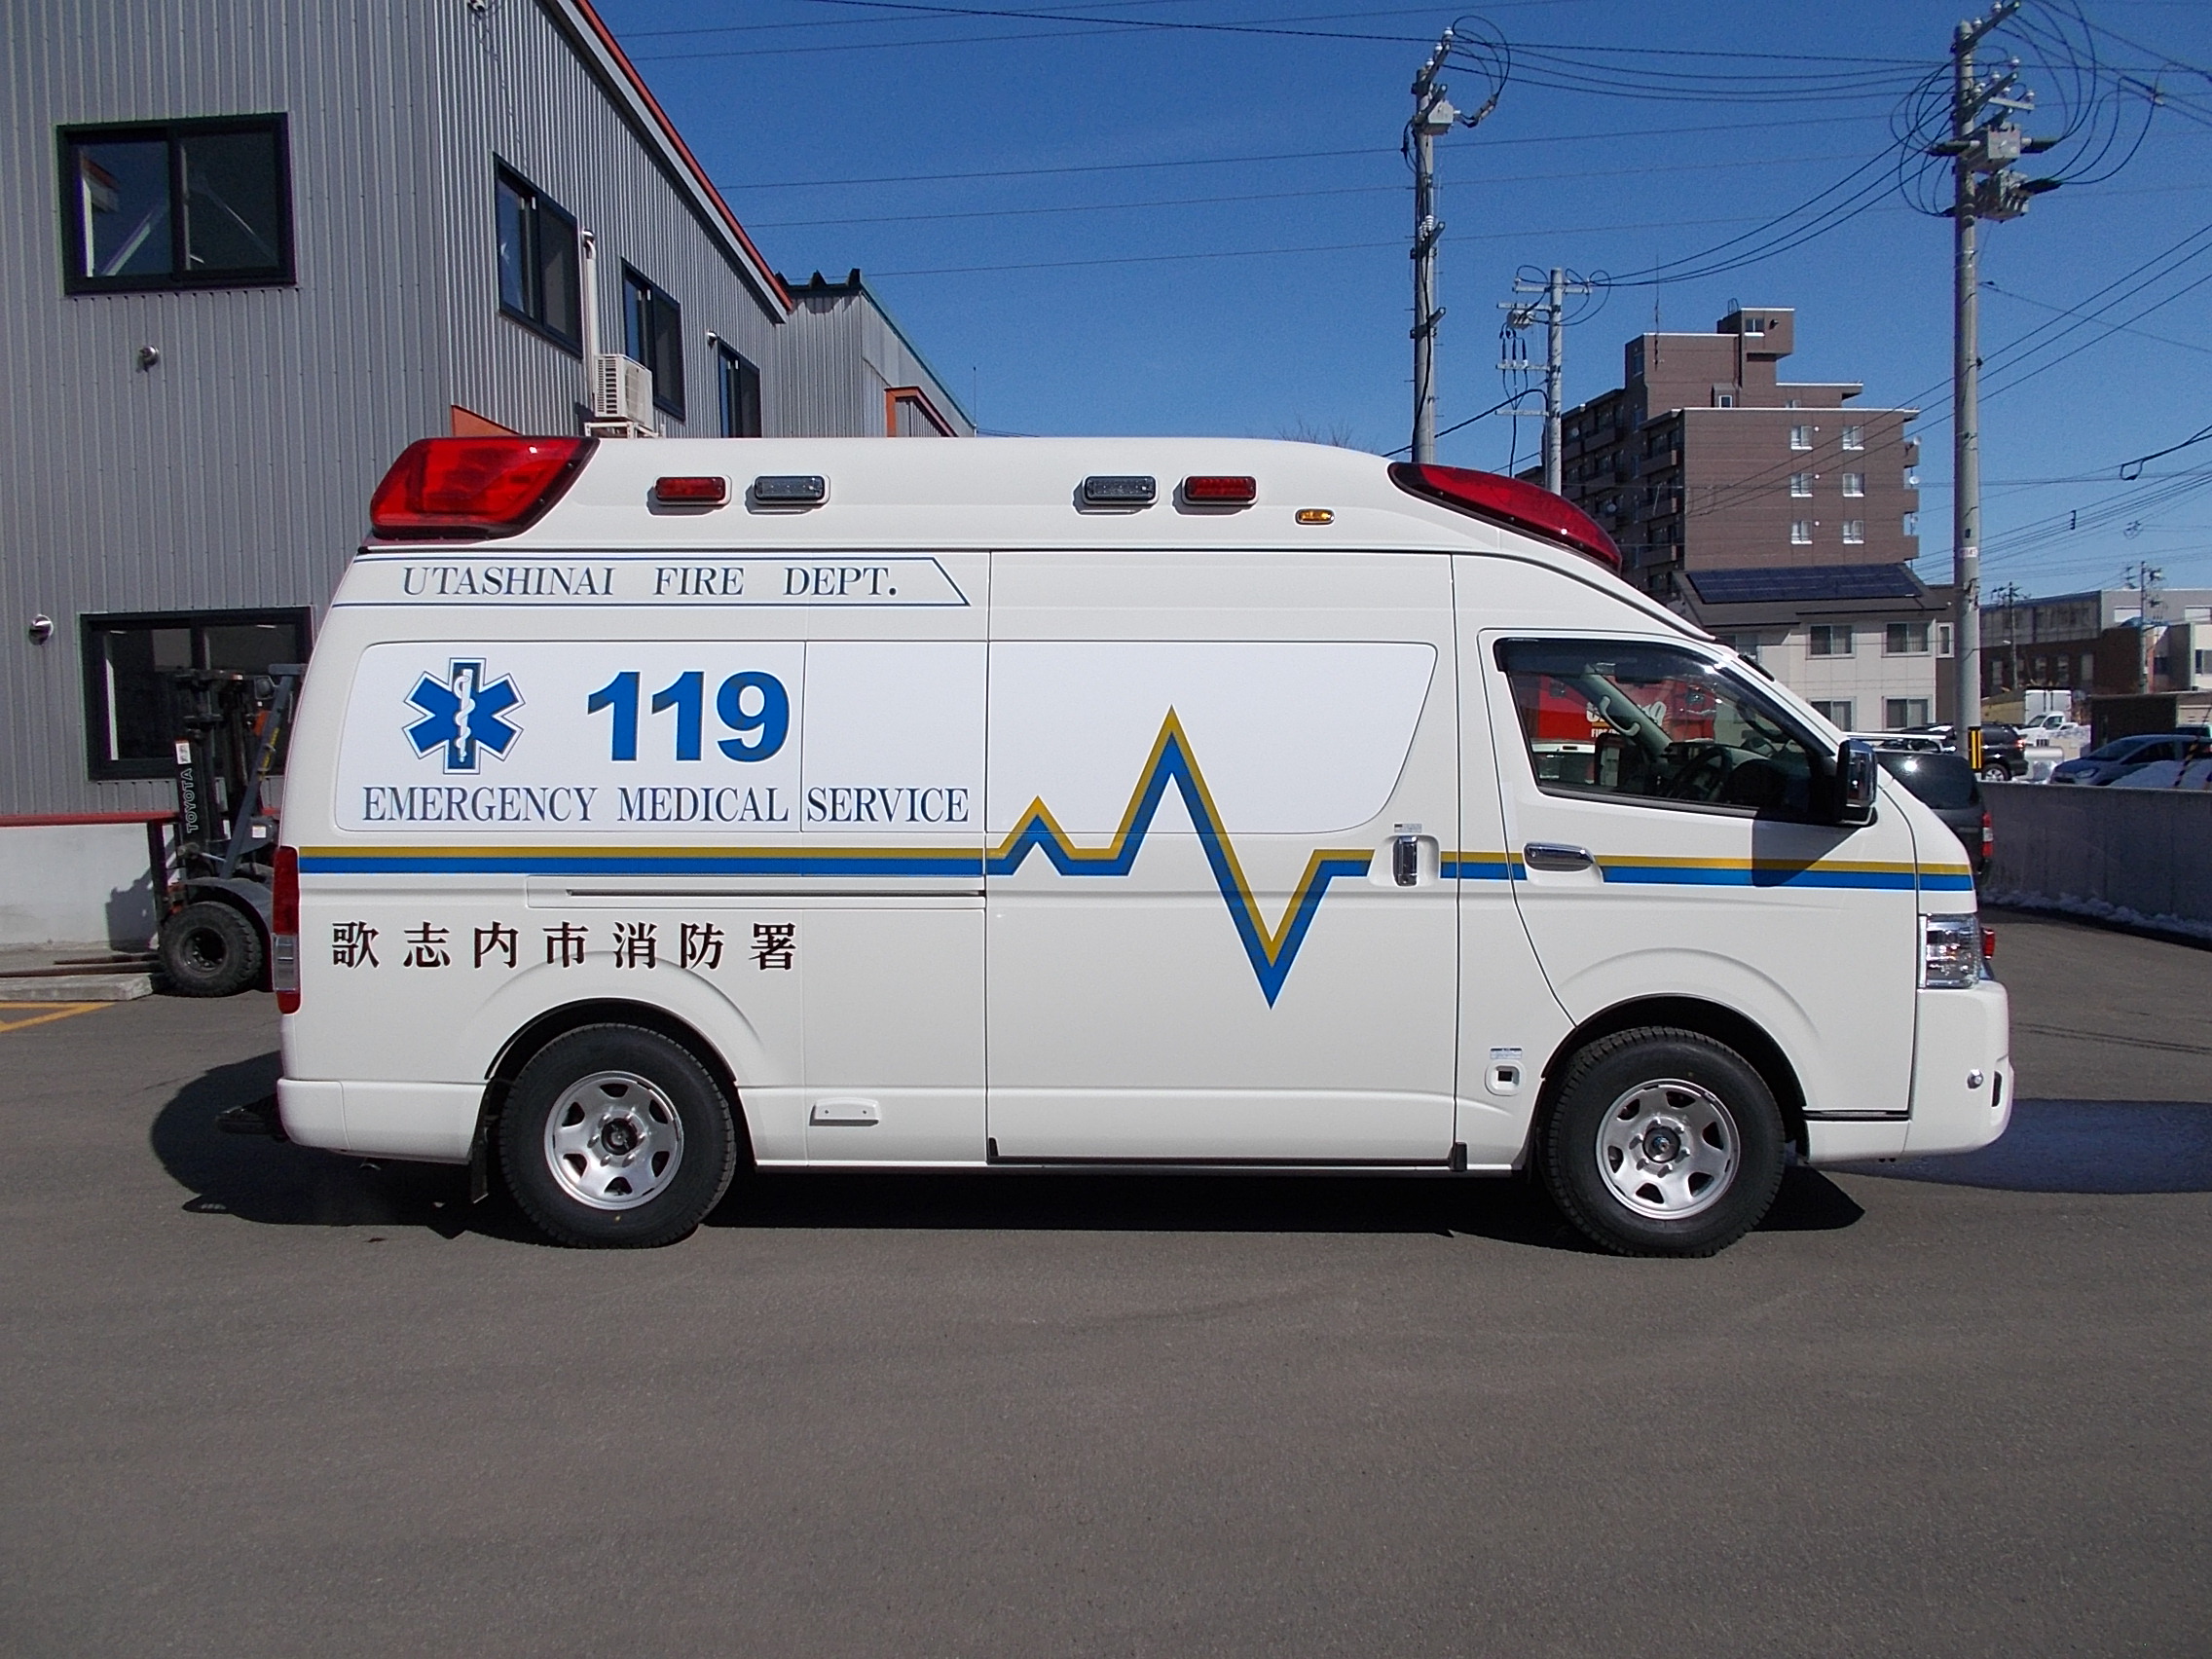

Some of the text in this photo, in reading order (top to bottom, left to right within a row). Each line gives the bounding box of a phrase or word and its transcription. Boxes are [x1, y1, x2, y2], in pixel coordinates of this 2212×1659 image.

[403, 568, 897, 596] UTASHINAI FIRE DEPT.
[587, 671, 791, 762] 119
[180, 767, 199, 833] TOYOTA
[362, 787, 969, 823] EMERGENCY MEDICAL SERVICE
[331, 921, 797, 971] 歌志内市消防署
